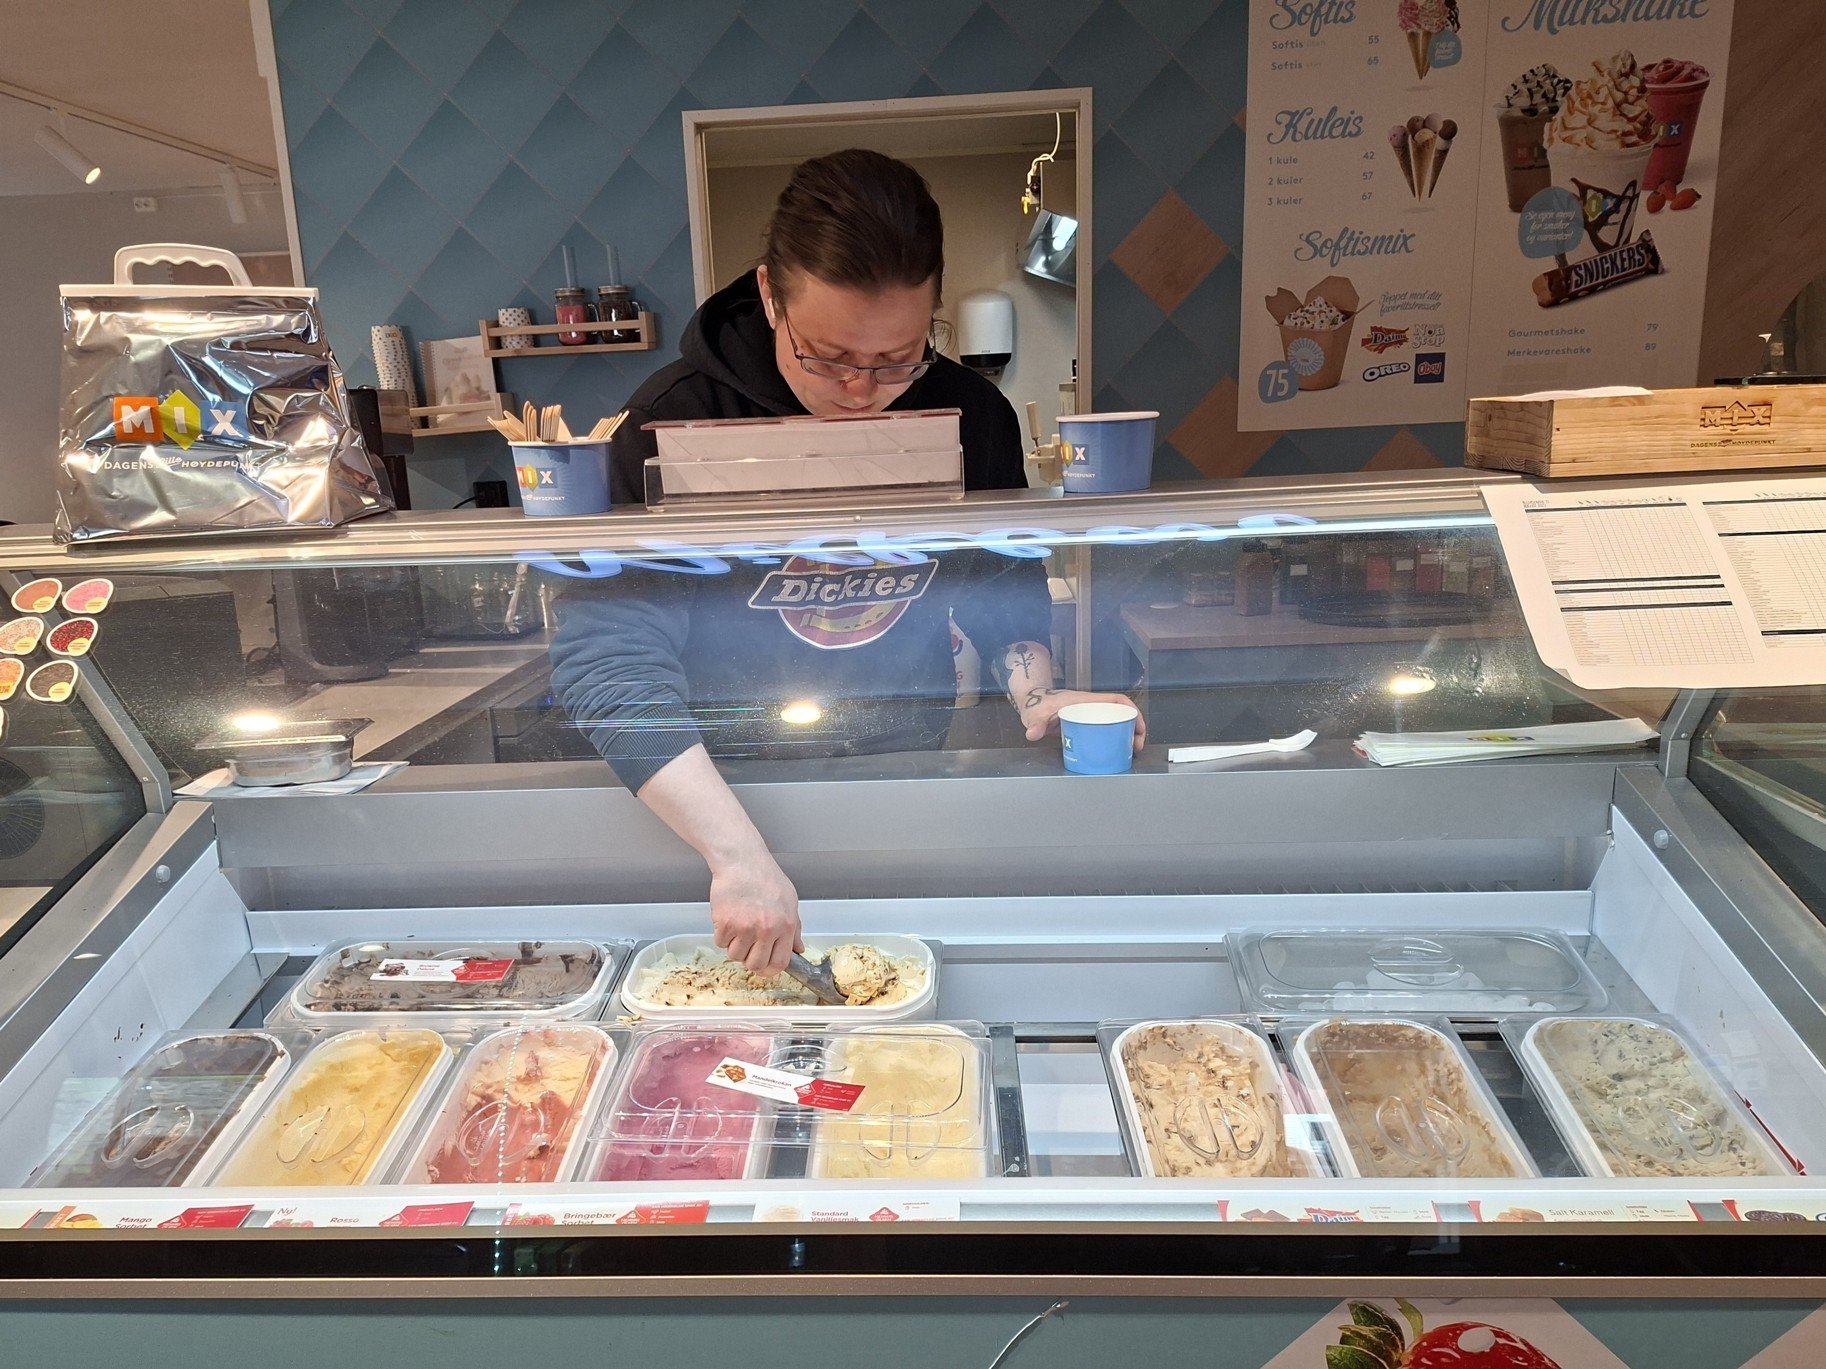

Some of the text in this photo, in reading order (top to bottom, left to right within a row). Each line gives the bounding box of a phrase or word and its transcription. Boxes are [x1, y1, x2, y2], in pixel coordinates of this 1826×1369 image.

[1272, 39, 1304, 50] Softis
[1368, 35, 1380, 44] 55
[1271, 60, 1303, 71] Softis
[1367, 57, 1379, 65] 65
[1267, 105, 1365, 145] Kuleis
[1276, 156, 1299, 165] kule
[1363, 151, 1375, 160] 42
[1268, 171, 1374, 186] 2 kuler 57
[1276, 196, 1304, 206] kuler
[1361, 192, 1373, 201] 67
[1294, 226, 1416, 267] Softismix
[1573, 243, 1647, 289] SNICKERS
[1413, 323, 1446, 338] Non
[1508, 322, 1659, 338] Gourmetshake 79
[1372, 331, 1405, 345] Daim
[1507, 342, 1656, 357] Merkevareshake 89
[1363, 362, 1411, 382] OREO
[1266, 369, 1290, 397] 75
[119, 404, 241, 437] MIX
[1703, 407, 1768, 428] MIX
[104, 460, 154, 470] DAGENS
[771, 572, 920, 603] Dickies
[752, 1074, 793, 1088] Mandelkrokan
[278, 1207, 298, 1217] Ny!
[563, 1212, 617, 1220] Bringebær
[1548, 1208, 1568, 1217] Salt
[1570, 1208, 1616, 1217] Karamell
[329, 1216, 360, 1224] Rosso
